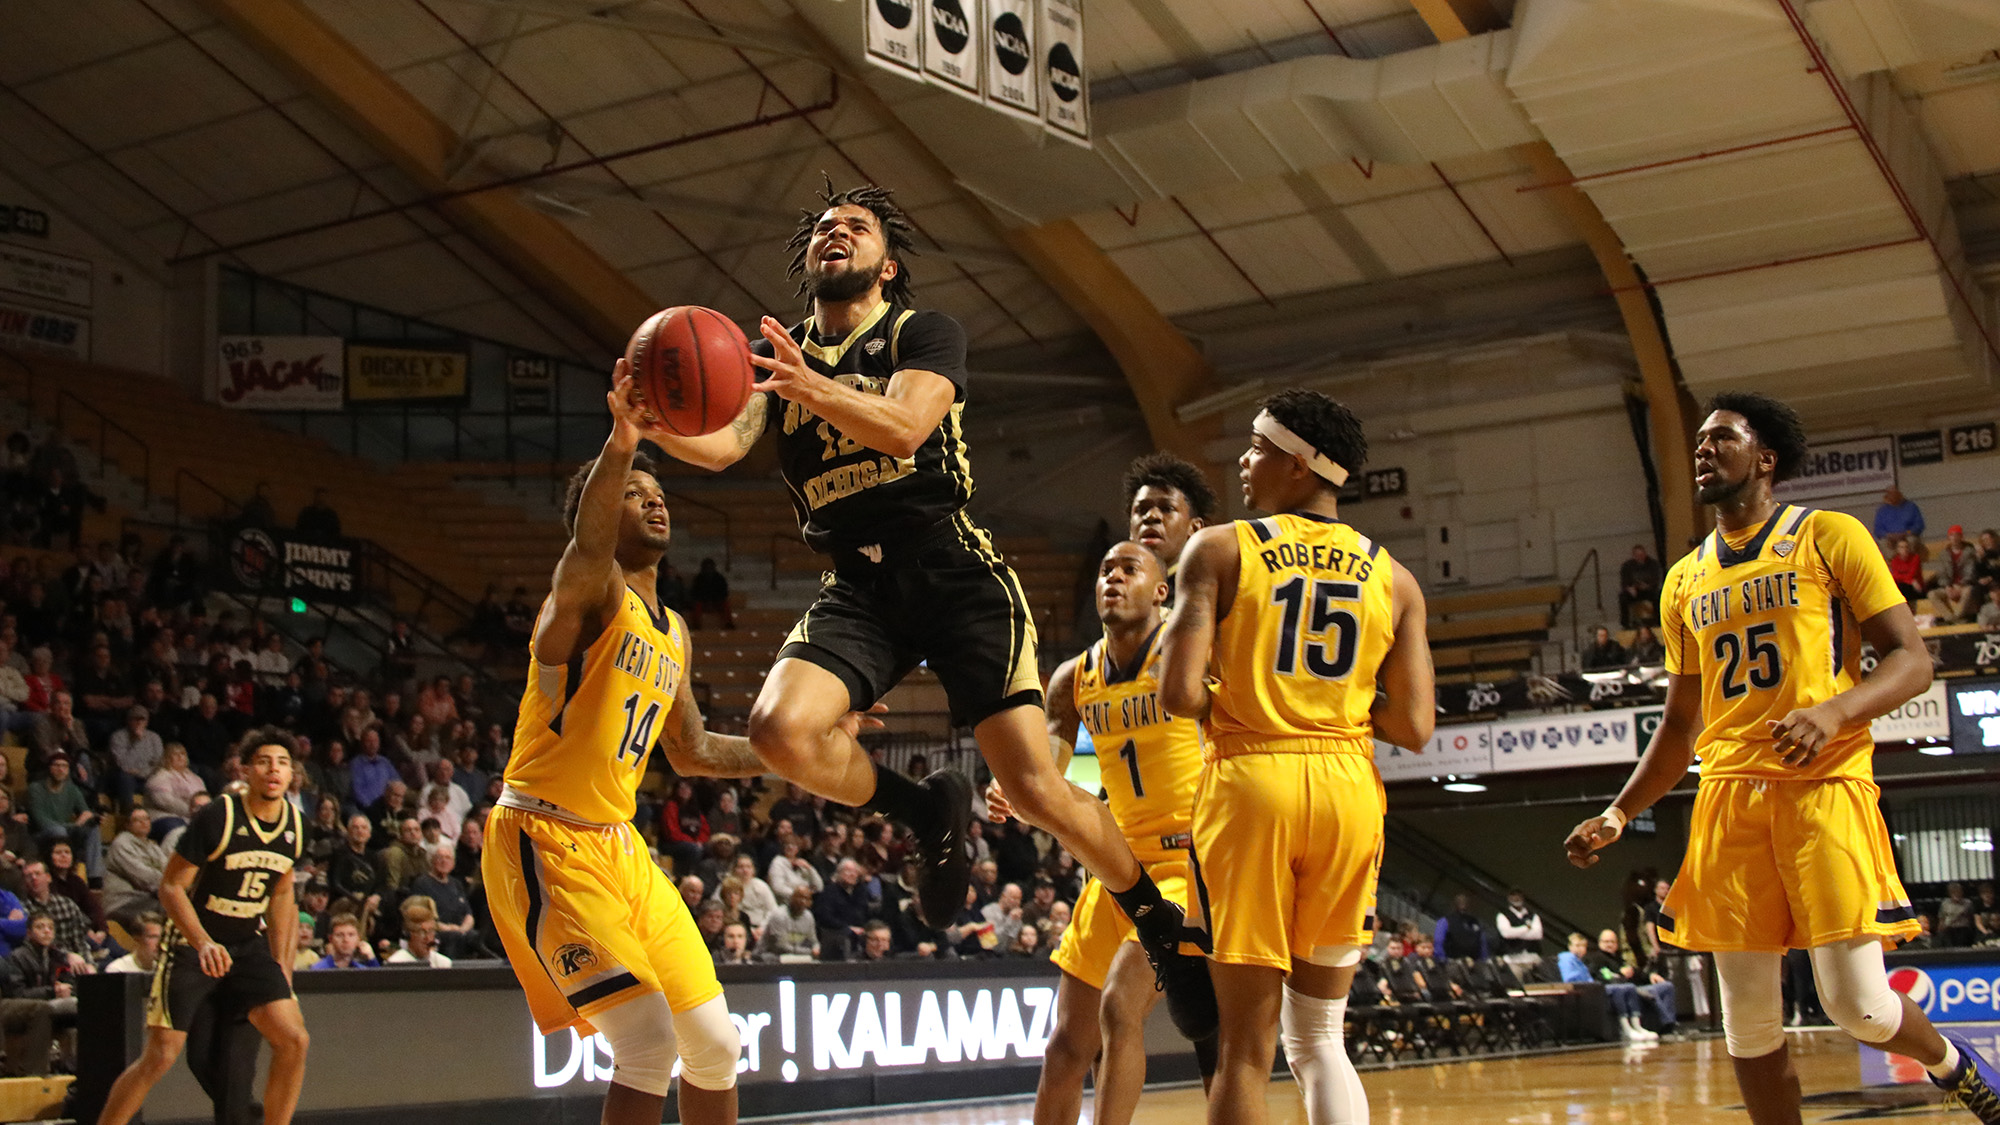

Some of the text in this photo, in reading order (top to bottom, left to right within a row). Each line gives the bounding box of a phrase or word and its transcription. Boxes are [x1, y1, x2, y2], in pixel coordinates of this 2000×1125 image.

[1954, 428, 1993, 452] 216
[283, 541, 352, 568] JIMMY
[1260, 543, 1373, 582] ROBERTS
[1270, 573, 1363, 681] 15
[1691, 571, 1800, 633] KENT STATE
[613, 630, 655, 683] KENT
[1713, 621, 1783, 702] 25
[615, 690, 663, 770] 14
[1119, 737, 1147, 798] 1
[237, 871, 270, 899] 15
[811, 987, 1059, 1070] KALAMAZ
